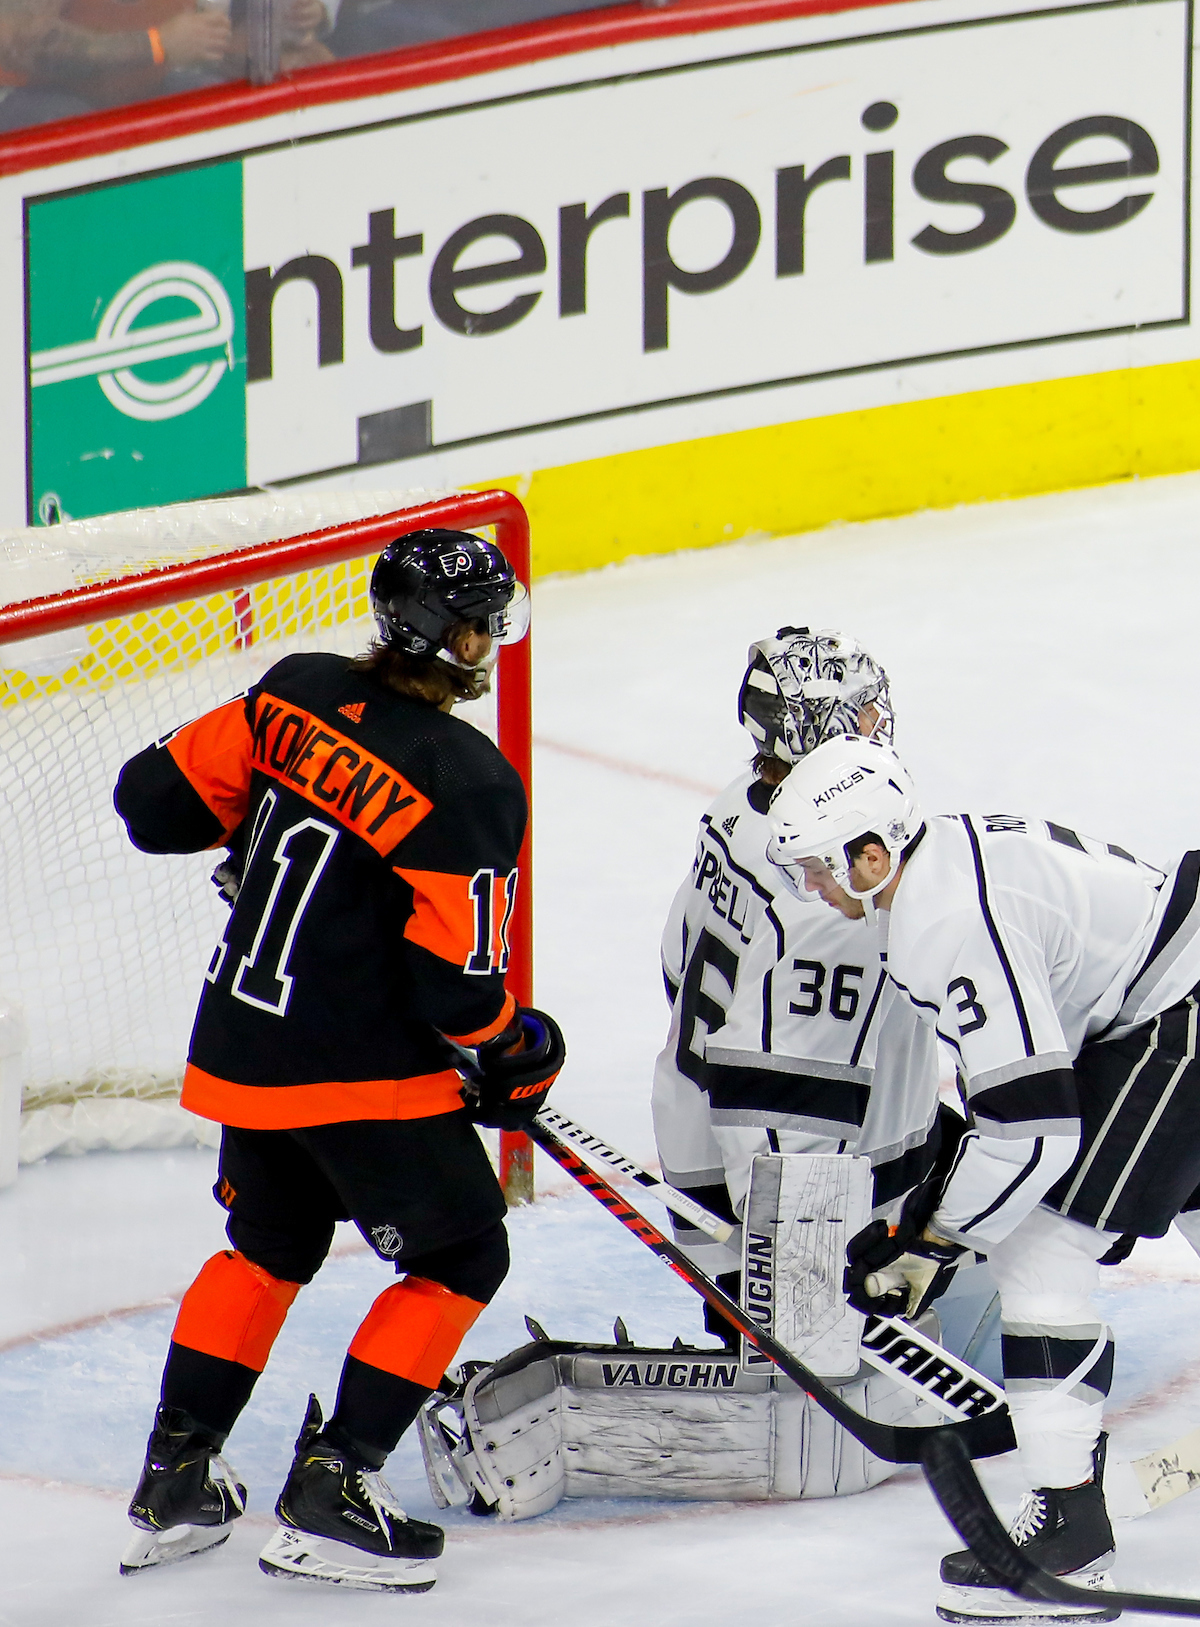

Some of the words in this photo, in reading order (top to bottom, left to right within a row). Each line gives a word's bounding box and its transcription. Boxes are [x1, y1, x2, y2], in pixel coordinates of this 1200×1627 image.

[30, 101, 1160, 421] enterprise
[812, 771, 865, 808] KINGS
[693, 840, 752, 946] PBELL
[787, 958, 866, 1023] 36
[945, 974, 989, 1039] 3
[537, 1106, 662, 1189] RRIOR
[747, 1233, 773, 1365] VUGHN
[602, 1363, 738, 1388] VAUGHN
